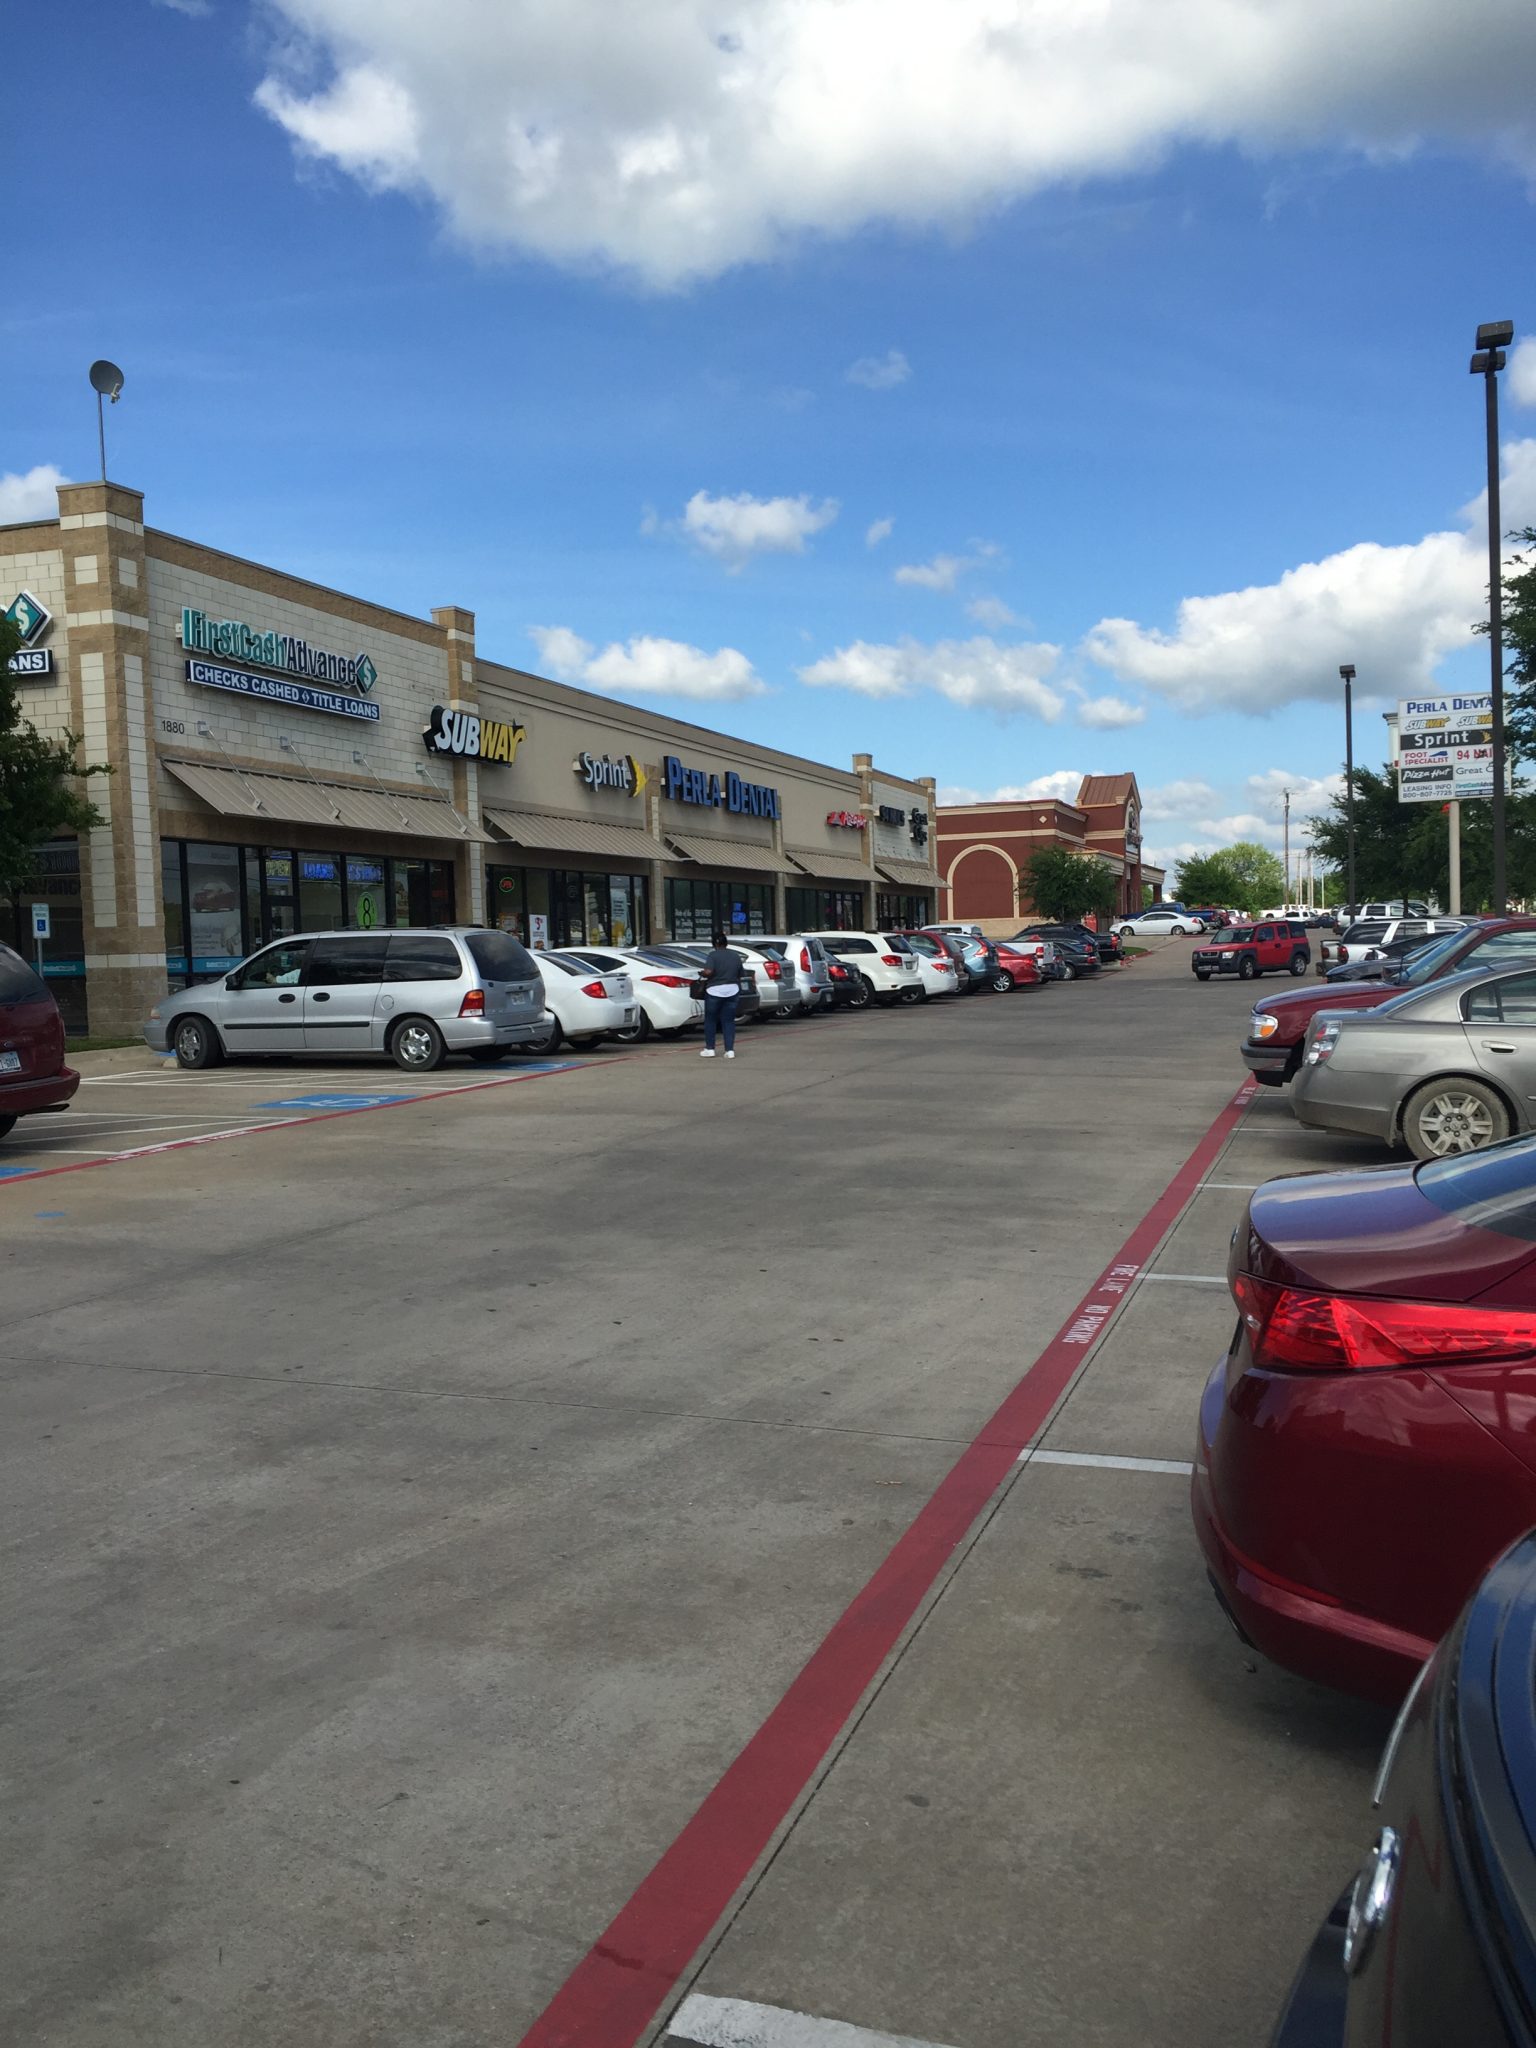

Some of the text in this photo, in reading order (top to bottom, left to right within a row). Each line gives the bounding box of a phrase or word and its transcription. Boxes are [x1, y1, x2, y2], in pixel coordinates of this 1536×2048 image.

[183, 606, 357, 687] FirstCashAdvance
[8, 653, 44, 671] ANS
[194, 664, 379, 720] CHECKS CASHED TITLE LOANS
[1407, 697, 1492, 714] PERLA DENTA
[161, 719, 186, 736] 1880
[1405, 716, 1451, 731] SUBWAY
[1457, 713, 1492, 728] SUBWA
[430, 706, 528, 766] SUBWAY
[1414, 730, 1470, 749] Sprint
[1404, 757, 1449, 765] SPECIALIST
[1405, 751, 1428, 759] FOOT
[1456, 748, 1492, 760] 94 NAI
[579, 751, 634, 792] Sprint
[1403, 768, 1452, 781] Pizza Hut
[1455, 766, 1483, 775] Great
[664, 756, 781, 820] PERLA DENTAL
[1403, 785, 1433, 793] LEASING
[1062, 1315, 1104, 1344] PARKING
